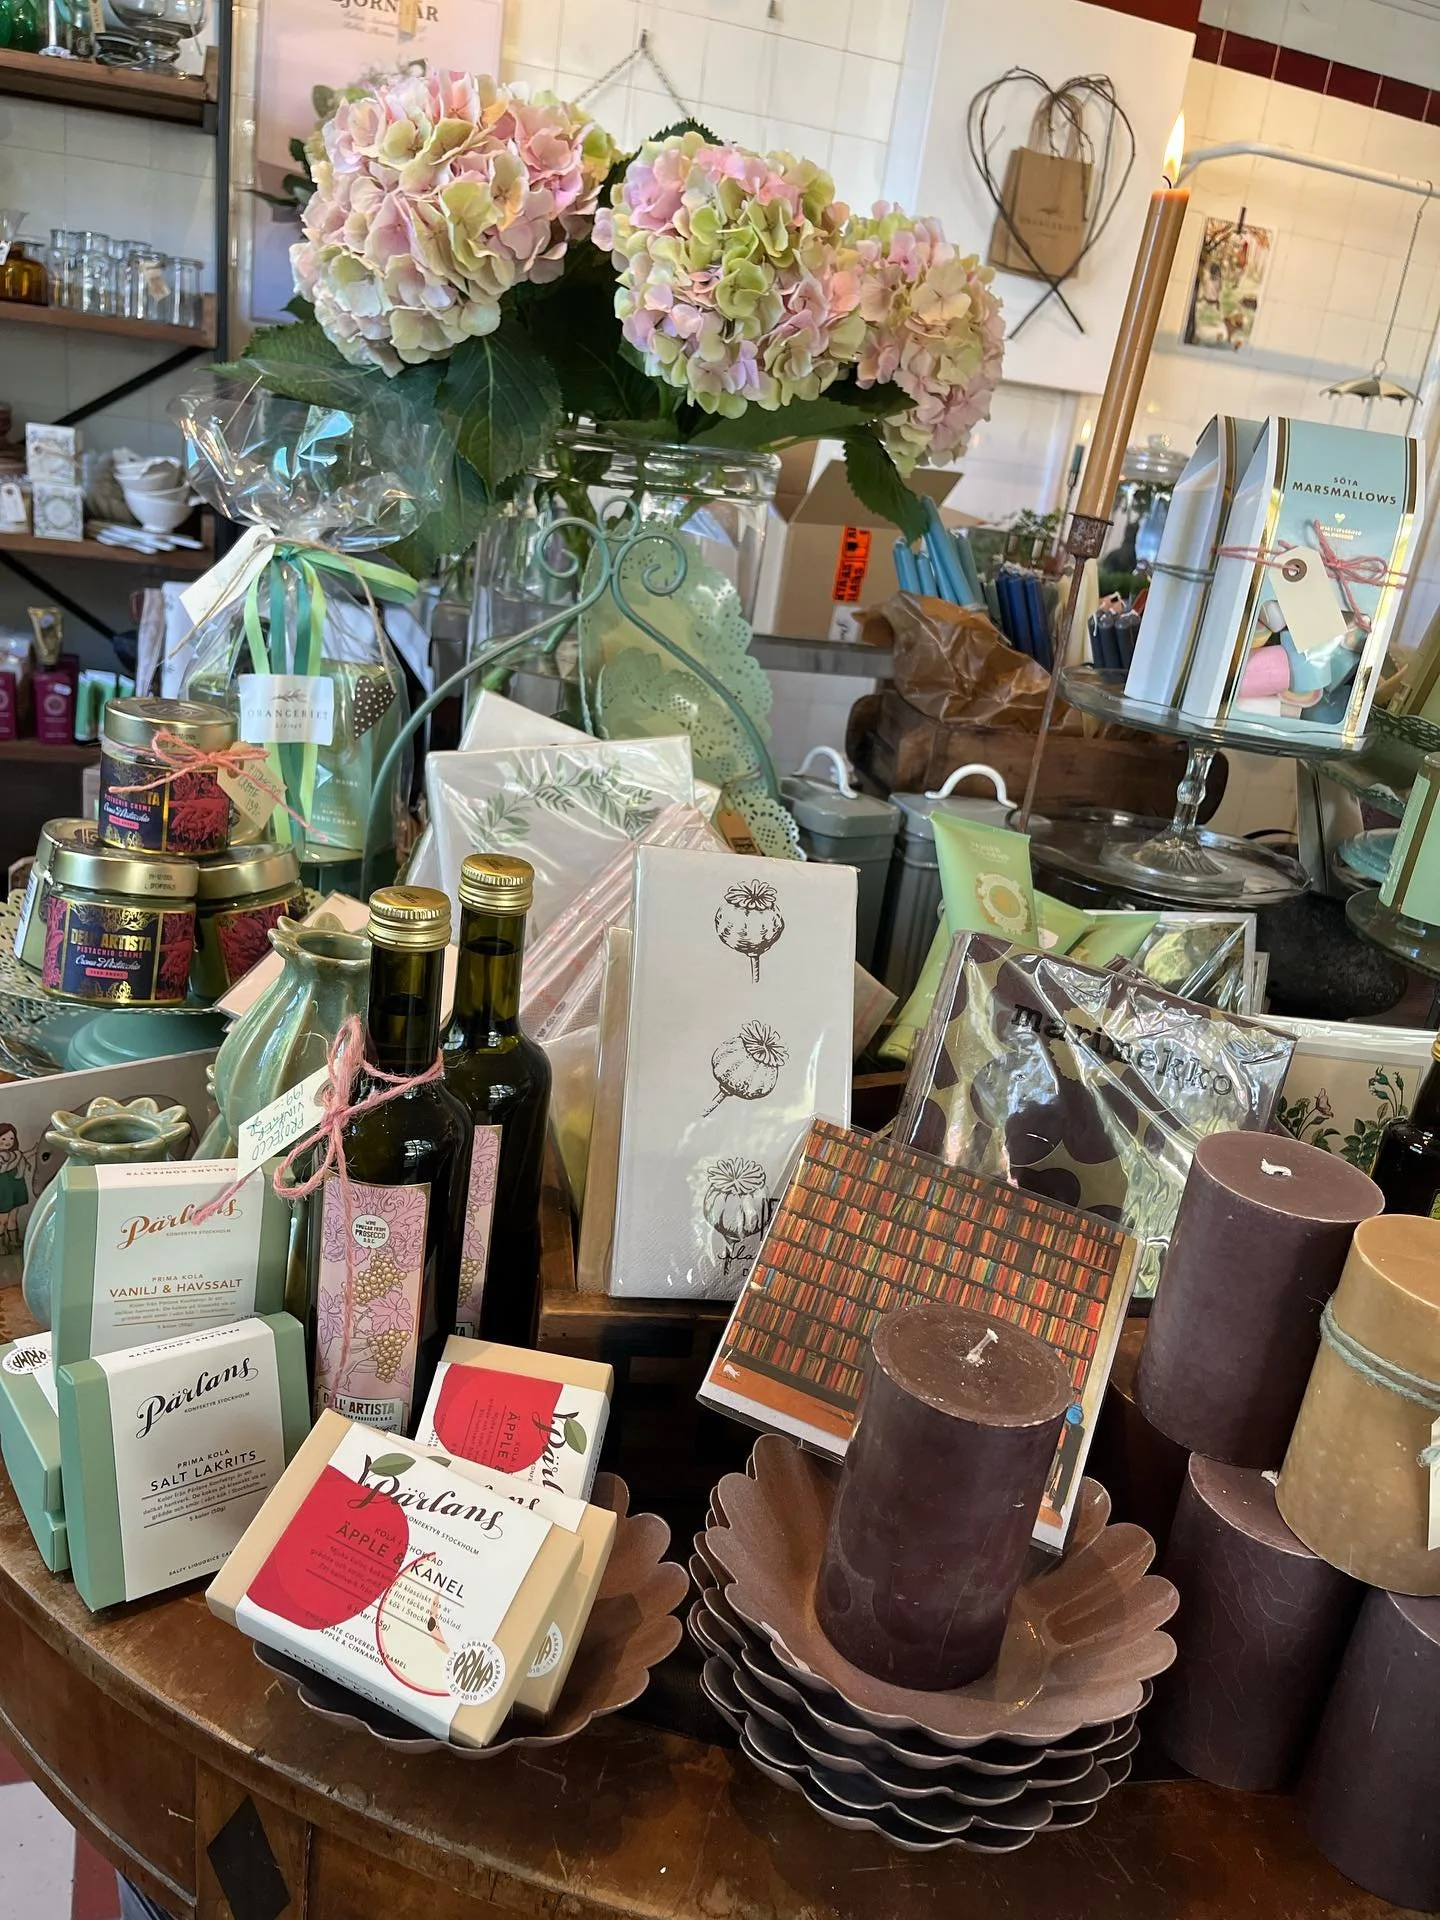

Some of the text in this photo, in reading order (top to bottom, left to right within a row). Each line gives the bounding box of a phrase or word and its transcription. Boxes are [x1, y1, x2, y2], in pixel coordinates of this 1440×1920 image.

[1292, 481, 1397, 505] MARSMALLOWS
[1333, 476, 1358, 487] SÖTA
[76, 945, 115, 958] PISTACHIO
[116, 1198, 243, 1250] Pärls
[355, 1228, 386, 1239] PROSECCO
[109, 1278, 243, 1298] VANILJ & HAVSSALT
[135, 1357, 259, 1439] Pärlans
[184, 1391, 250, 1413] KONFEKTYR STOCKHOLM
[323, 1392, 395, 1415] DLL' ARTISTA
[498, 1411, 521, 1460] ÄPPLE
[151, 1450, 257, 1492] SALT LAKRITS
[177, 1449, 230, 1469] PRIMA KOLA
[347, 1474, 504, 1540] Pärlans
[374, 1527, 398, 1543] KOLA
[405, 1513, 481, 1556] KONFEKTYR STOCKHOLM
[168, 1555, 220, 1576] SALTY LIQUORICE
[336, 1520, 390, 1558] ÄPPLE
[393, 1554, 405, 1567] &
[410, 1560, 465, 1599] KANEL
[393, 1589, 405, 1602] fint
[406, 1597, 425, 1611] täcke
[403, 1584, 432, 1604] klassiskt
[388, 1598, 401, 1611] kök
[405, 1607, 441, 1631] Stockhm.
[320, 1628, 339, 1642] APPLE
[348, 1642, 384, 1667] CINNAMON
[344, 1632, 375, 1653] COVERED
[376, 1649, 407, 1669] CARAMEL
[446, 1640, 501, 1695] KOLA CARAMEL KARAMEL
[453, 1648, 494, 1693] PRIMA
[449, 1683, 478, 1701] EST 2010
